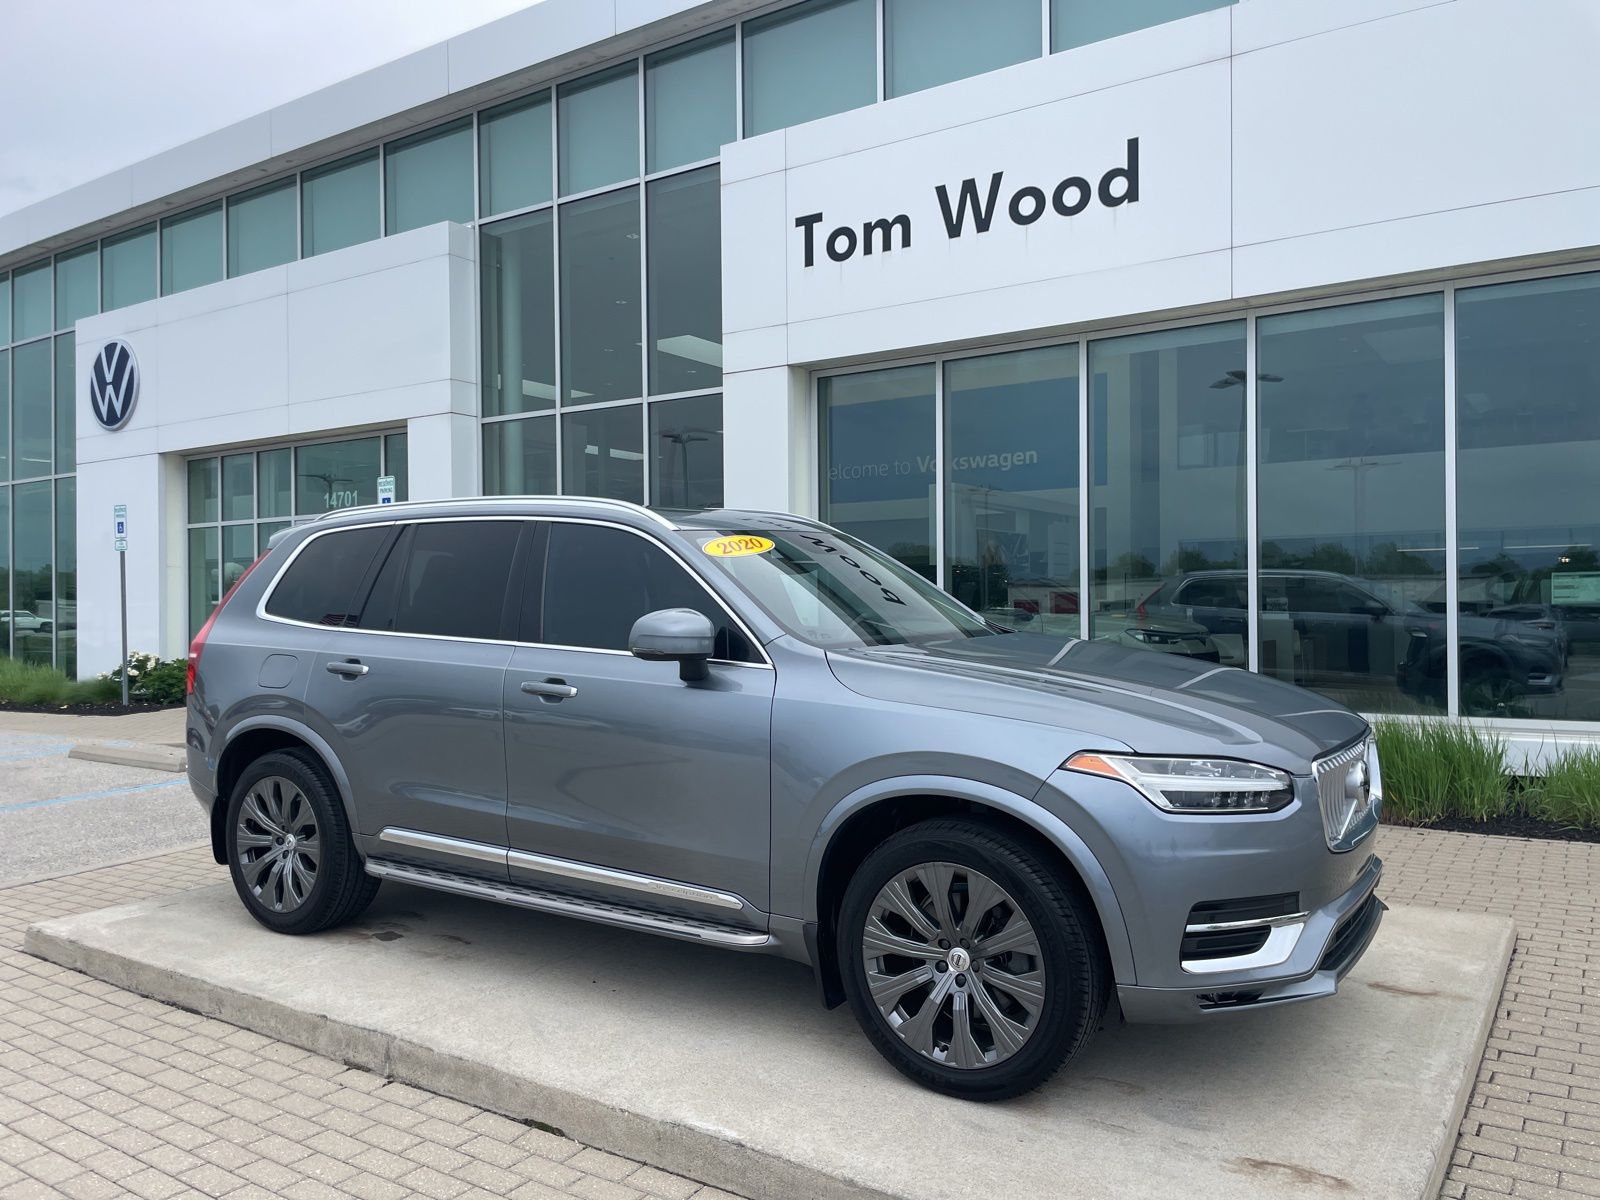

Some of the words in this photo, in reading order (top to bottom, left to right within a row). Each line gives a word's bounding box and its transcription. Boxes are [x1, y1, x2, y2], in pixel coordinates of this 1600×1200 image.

[795, 212, 911, 268] Tom
[935, 137, 1140, 239] Wood
[91, 341, 136, 423] VW
[829, 463, 889, 480] elcome
[895, 459, 911, 475] to
[323, 489, 358, 509] 14701
[716, 537, 763, 555] 2020
